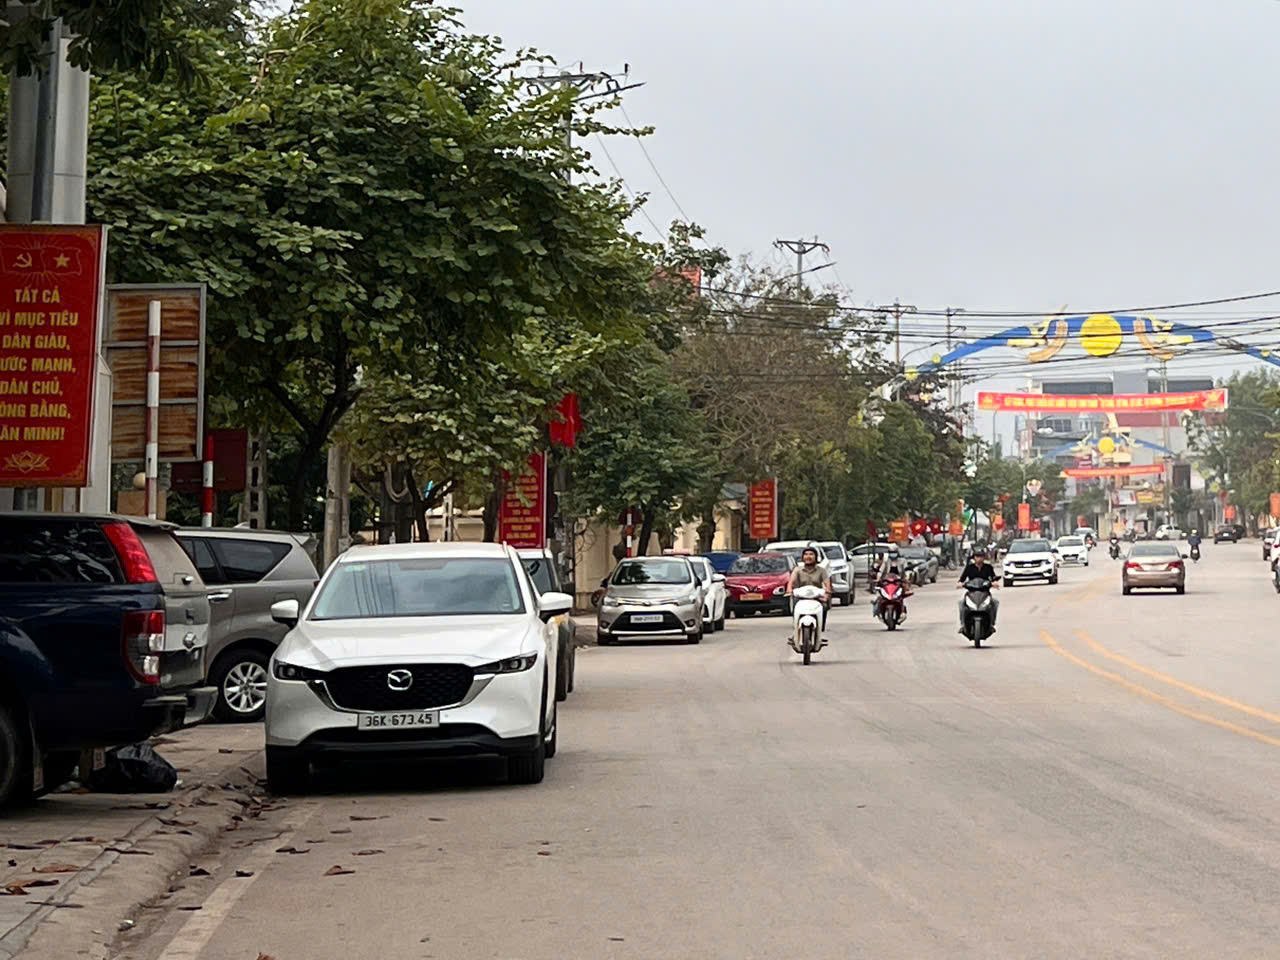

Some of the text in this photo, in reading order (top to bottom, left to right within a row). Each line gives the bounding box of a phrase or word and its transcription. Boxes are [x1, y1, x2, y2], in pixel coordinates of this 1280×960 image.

[14, 284, 61, 304] TẤT CẢ
[14, 311, 46, 329] MỤC
[49, 309, 79, 327] TIÊU
[2, 331, 71, 351] DÂN GIÀU,
[31, 357, 77, 375] MẠNH,
[0, 376, 64, 396] DÂN CHỦ,
[30, 399, 72, 419] BẰNG,
[23, 426, 65, 441] MINH!
